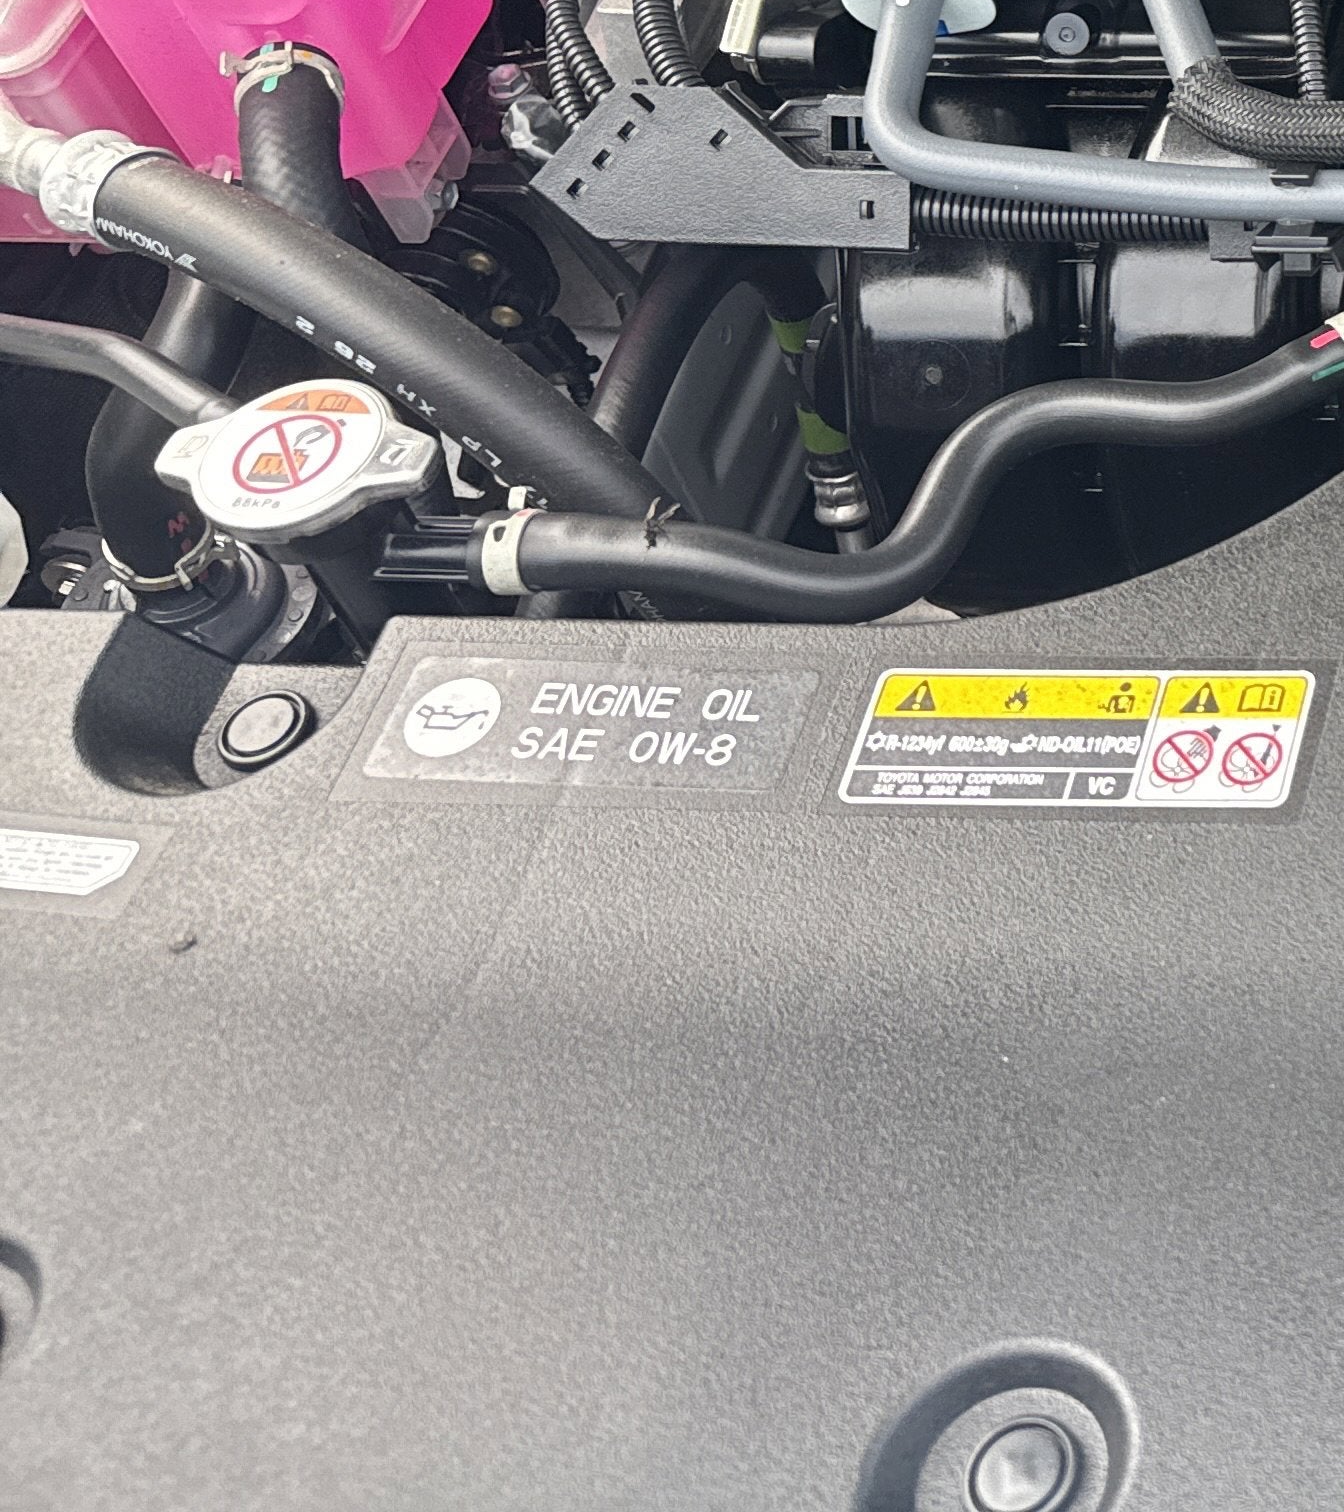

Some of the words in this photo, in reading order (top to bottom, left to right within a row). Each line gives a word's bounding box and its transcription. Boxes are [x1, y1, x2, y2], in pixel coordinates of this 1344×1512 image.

[96, 216, 174, 261] YOKOHAM
[462, 435, 502, 468] LP
[530, 682, 682, 719] ENGINE
[701, 688, 760, 722] OIL
[510, 726, 606, 761] SAE
[628, 731, 737, 766] 0W-8
[876, 772, 920, 784] TOYOTA
[923, 772, 963, 784] MOTOR
[966, 773, 1045, 785] CORPORATION
[1087, 776, 1117, 795] VC
